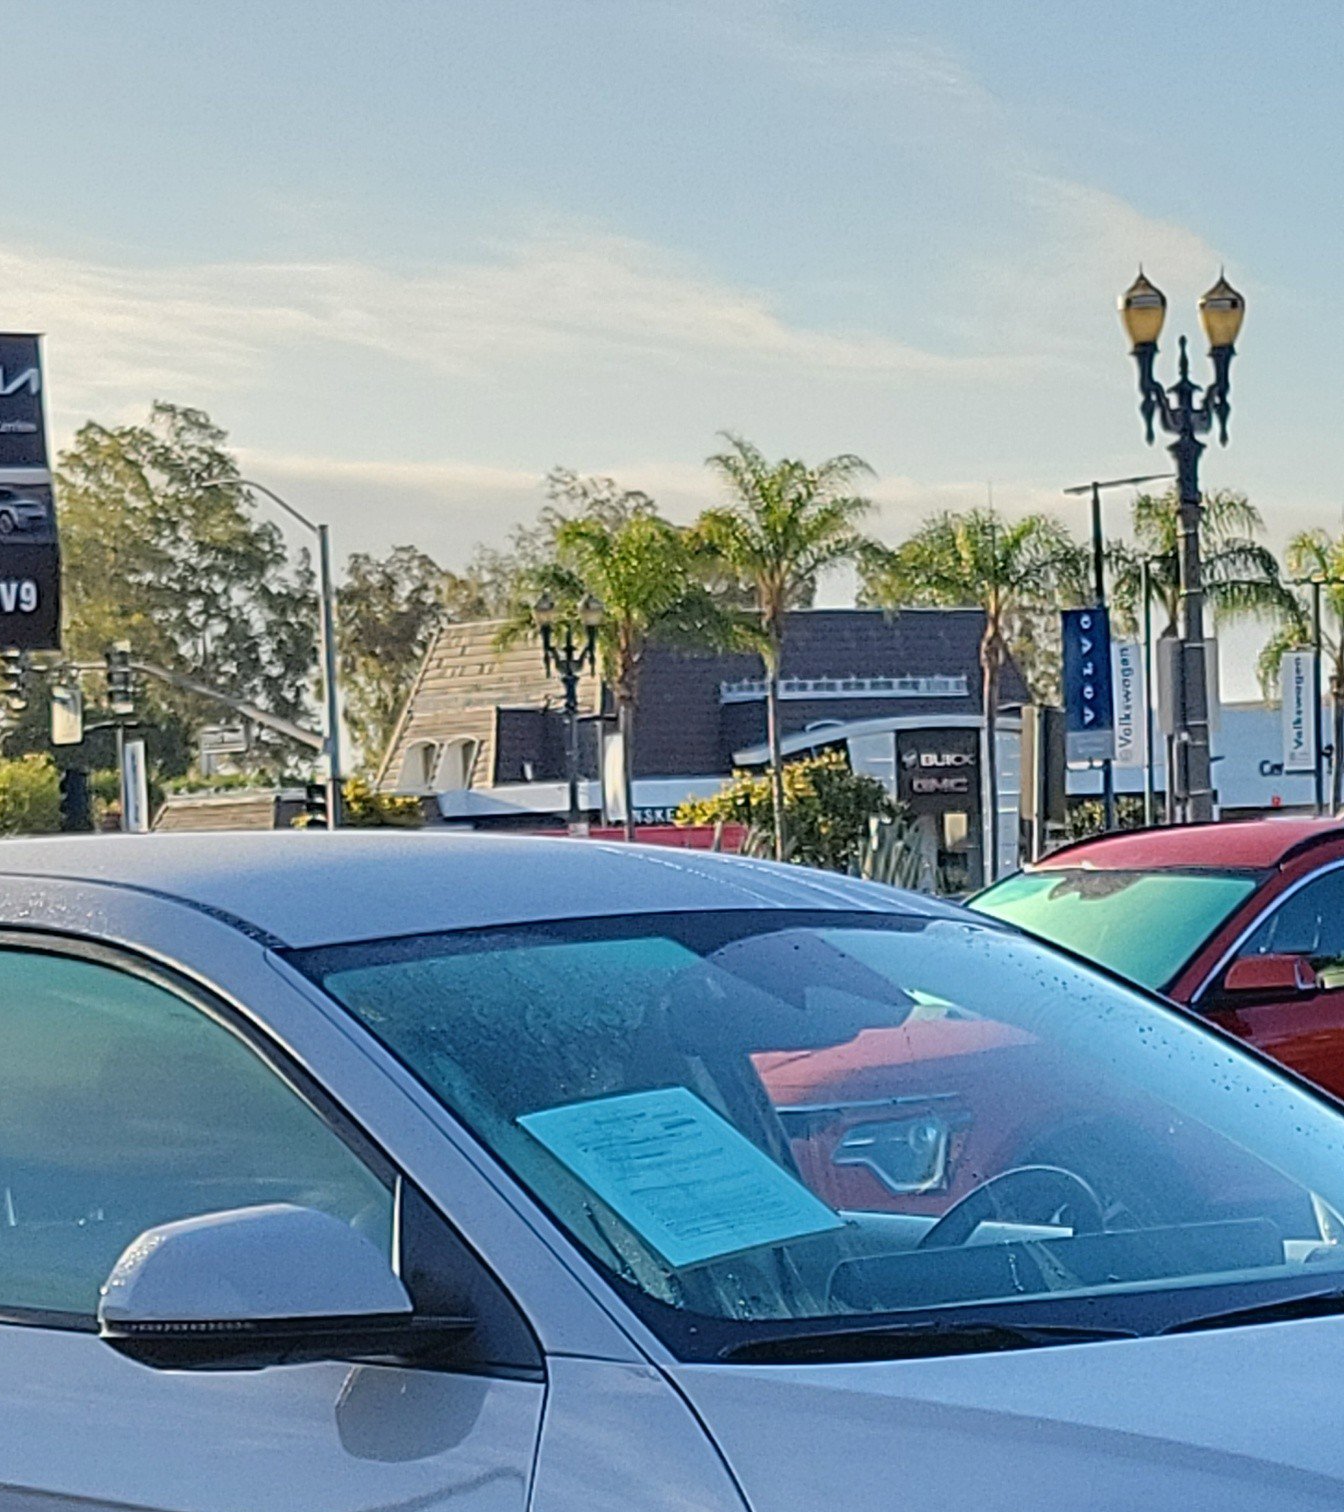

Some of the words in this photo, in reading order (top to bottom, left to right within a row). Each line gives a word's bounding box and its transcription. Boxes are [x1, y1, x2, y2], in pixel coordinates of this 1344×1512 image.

[1080, 614, 1095, 725] VOLVO
[1119, 647, 1134, 748] Volkswagen
[912, 777, 968, 793] GMC
[920, 753, 976, 767] BUICK
